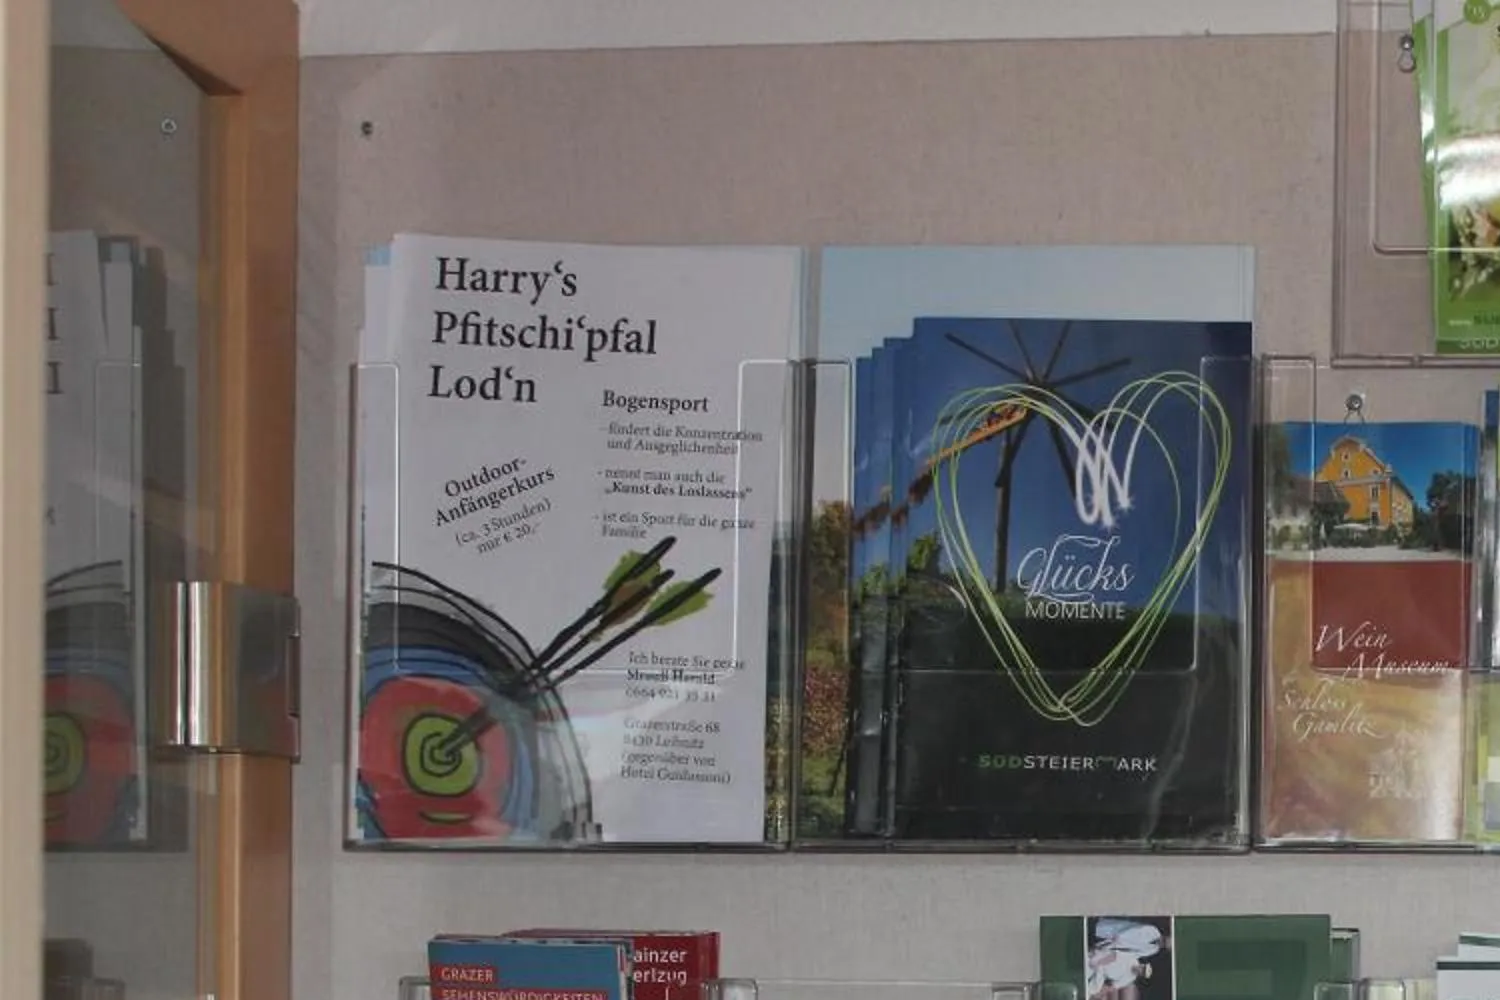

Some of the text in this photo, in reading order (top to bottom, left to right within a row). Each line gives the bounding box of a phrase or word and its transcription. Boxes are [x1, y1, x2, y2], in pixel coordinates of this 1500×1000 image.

[602, 390, 708, 414] Bogensport
[433, 468, 555, 527] Anfängerkurs
[653, 483, 675, 496] des
[1018, 535, 1135, 605] Glücks
[1025, 601, 1126, 620] MOMENTE
[634, 948, 688, 963] ainzer
[441, 967, 493, 982] GRAZER
[634, 969, 688, 985] erlzug
